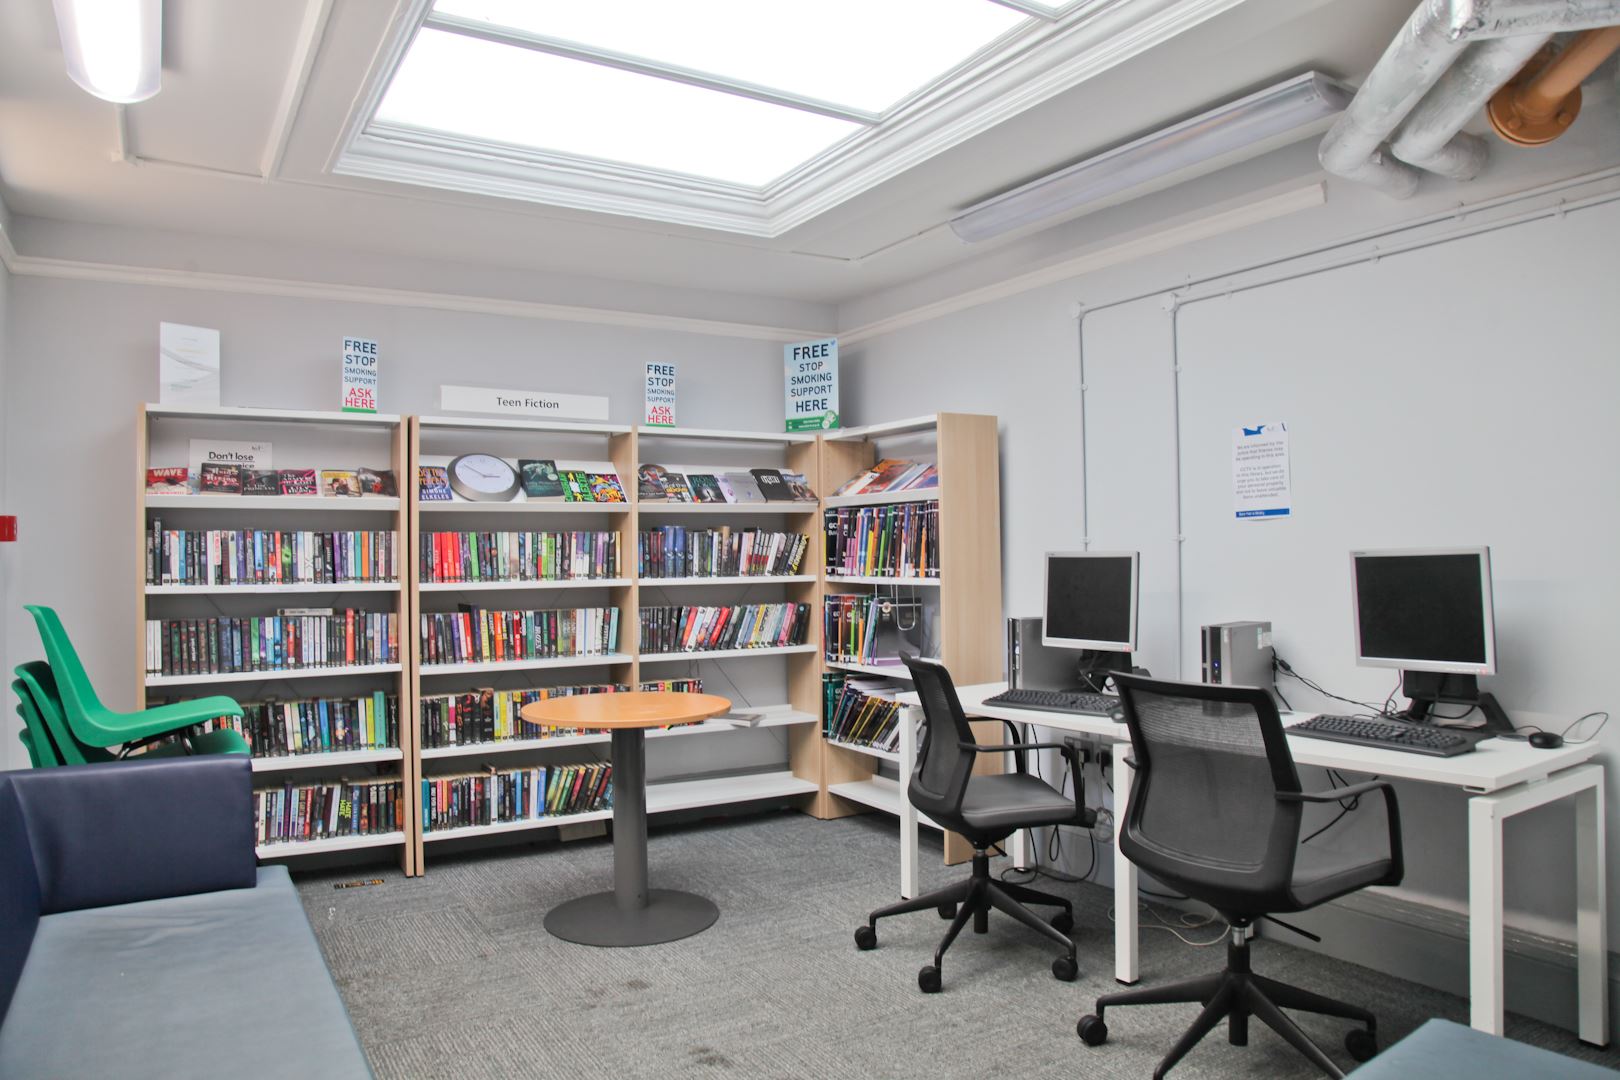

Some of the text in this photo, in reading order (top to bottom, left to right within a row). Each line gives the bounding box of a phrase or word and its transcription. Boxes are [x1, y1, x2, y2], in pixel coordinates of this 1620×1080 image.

[344, 339, 377, 355] FREE
[793, 343, 829, 360] FREE
[345, 354, 376, 367] STOP
[799, 361, 824, 372] STOP
[344, 367, 377, 376] SMOKING
[647, 364, 675, 376] FREE
[344, 376, 377, 385] SUPPORT
[648, 377, 674, 387] STOP
[791, 372, 832, 385] SMOKING
[349, 387, 372, 399] ASK
[647, 388, 675, 396] SMOKING
[790, 384, 832, 397] SUPPORT
[345, 397, 375, 409] HERE
[496, 397, 559, 409] Teen Fiction
[647, 396, 675, 404] SUPPORT
[796, 398, 828, 413] HERE
[651, 406, 671, 415] ASK
[648, 415, 674, 424] HERE
[208, 451, 254, 461] Don't lose
[339, 800, 347, 817] HATE
[344, 801, 352, 819] HATE
